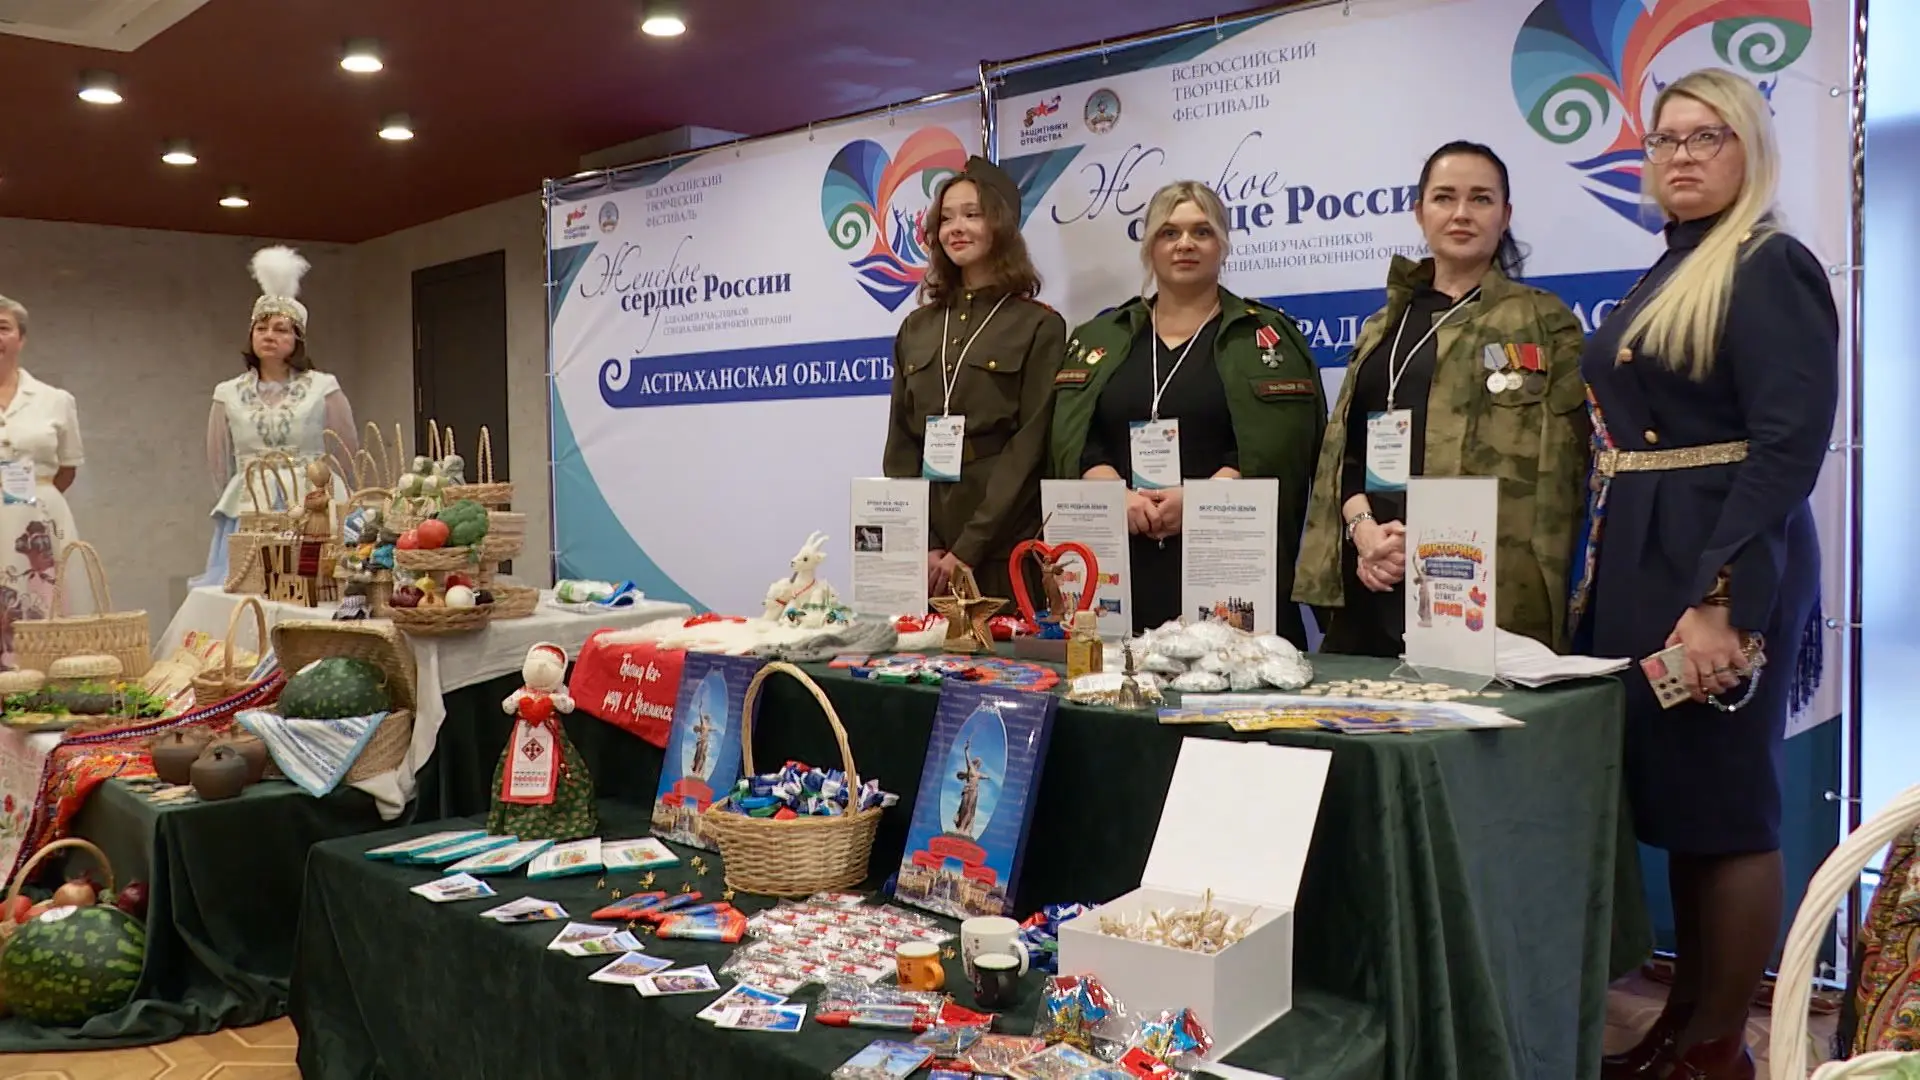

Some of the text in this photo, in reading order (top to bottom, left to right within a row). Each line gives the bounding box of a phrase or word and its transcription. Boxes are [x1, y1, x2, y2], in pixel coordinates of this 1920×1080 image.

[1172, 42, 1317, 82] ВСЕРОССИЙСКИЙ
[1172, 70, 1281, 102] ТВОРЧЕСКИЙ
[1172, 94, 1270, 122] ФЕСТИВАЛЬ
[645, 174, 722, 199] ВСЕРОССИЙСКИЙ
[646, 192, 703, 212] ТВОРЧЕСКИЙ
[1284, 184, 1419, 225] Росси
[645, 209, 697, 227] ФЕСТИВАЛЬ
[1236, 240, 1278, 257] СЕМЕЙ
[1280, 231, 1373, 251] УЧАСТНИКОВ
[1309, 248, 1375, 265] ВОЕННОЙ
[1377, 244, 1429, 260] ОПЕРА
[621, 273, 792, 316] сердце России
[640, 356, 895, 395] АСТРАХАНСКАЯ ОБЛАСТЬ
